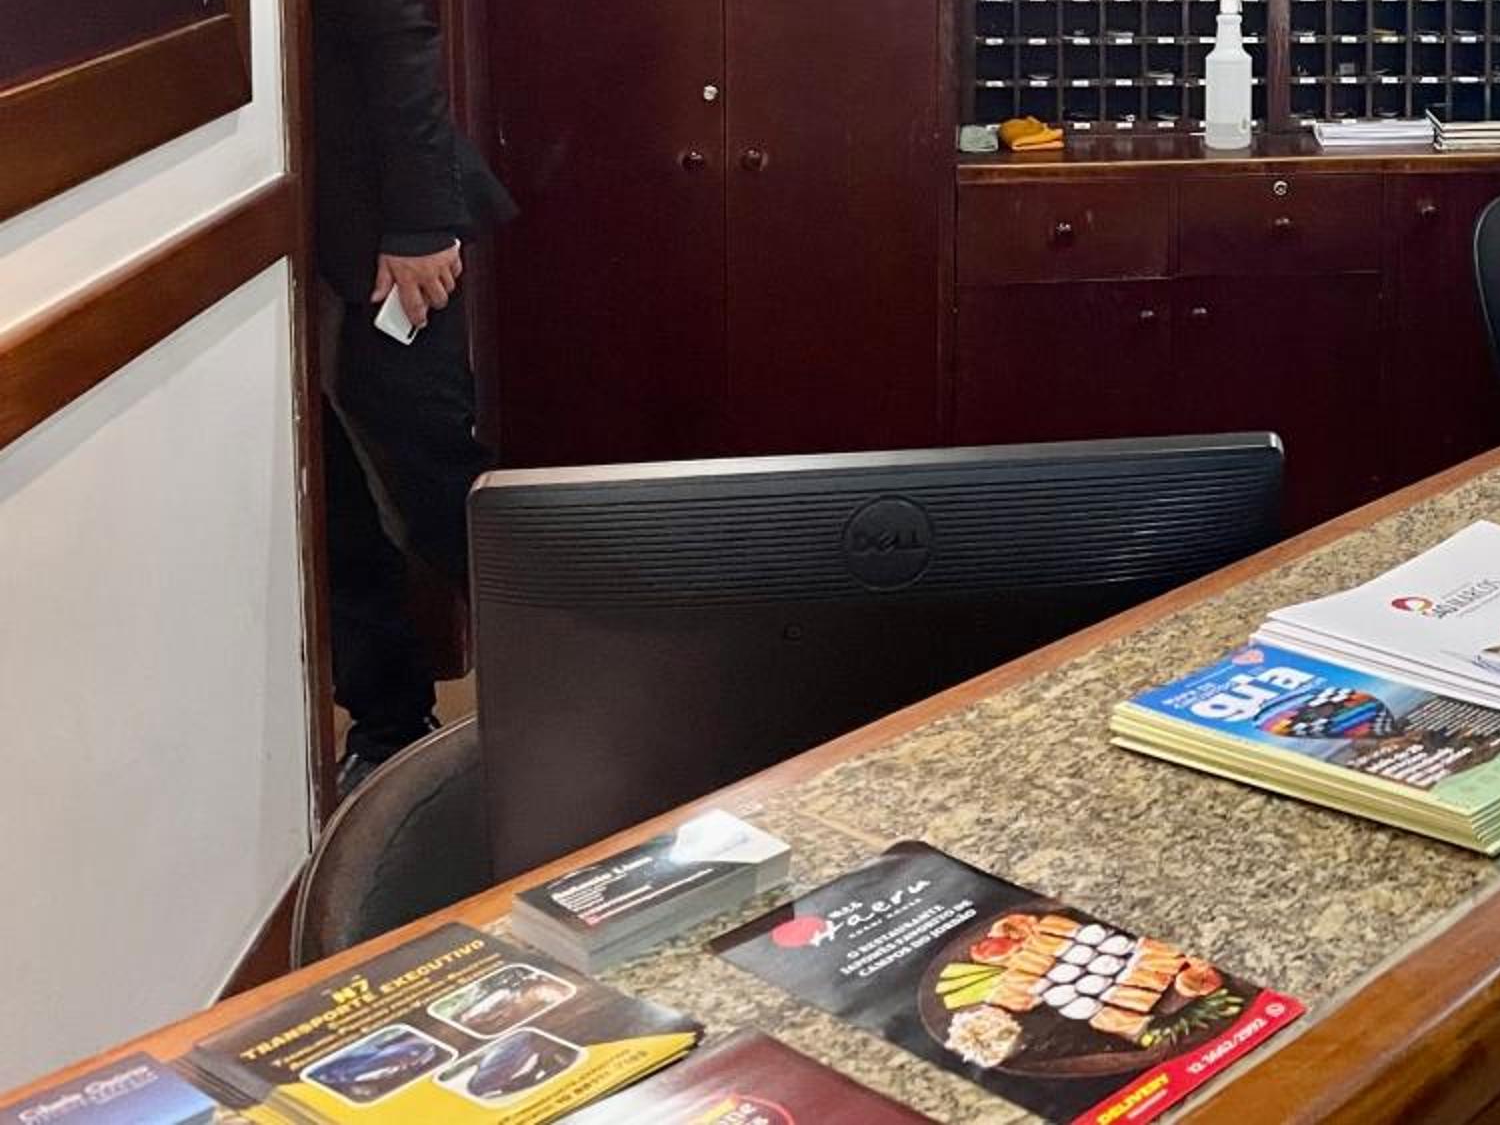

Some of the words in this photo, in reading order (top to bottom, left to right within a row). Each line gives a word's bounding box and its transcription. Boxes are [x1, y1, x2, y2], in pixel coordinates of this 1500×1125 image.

[859, 904, 945, 953] RESTAURANTE
[859, 946, 912, 977] CAMPOS
[910, 935, 932, 949] DO
[930, 908, 977, 938] JORDÃO
[239, 992, 379, 1061] TRANSPORTE
[379, 939, 486, 994] EXECUTIVO
[1096, 1073, 1169, 1125] DELIVERY
